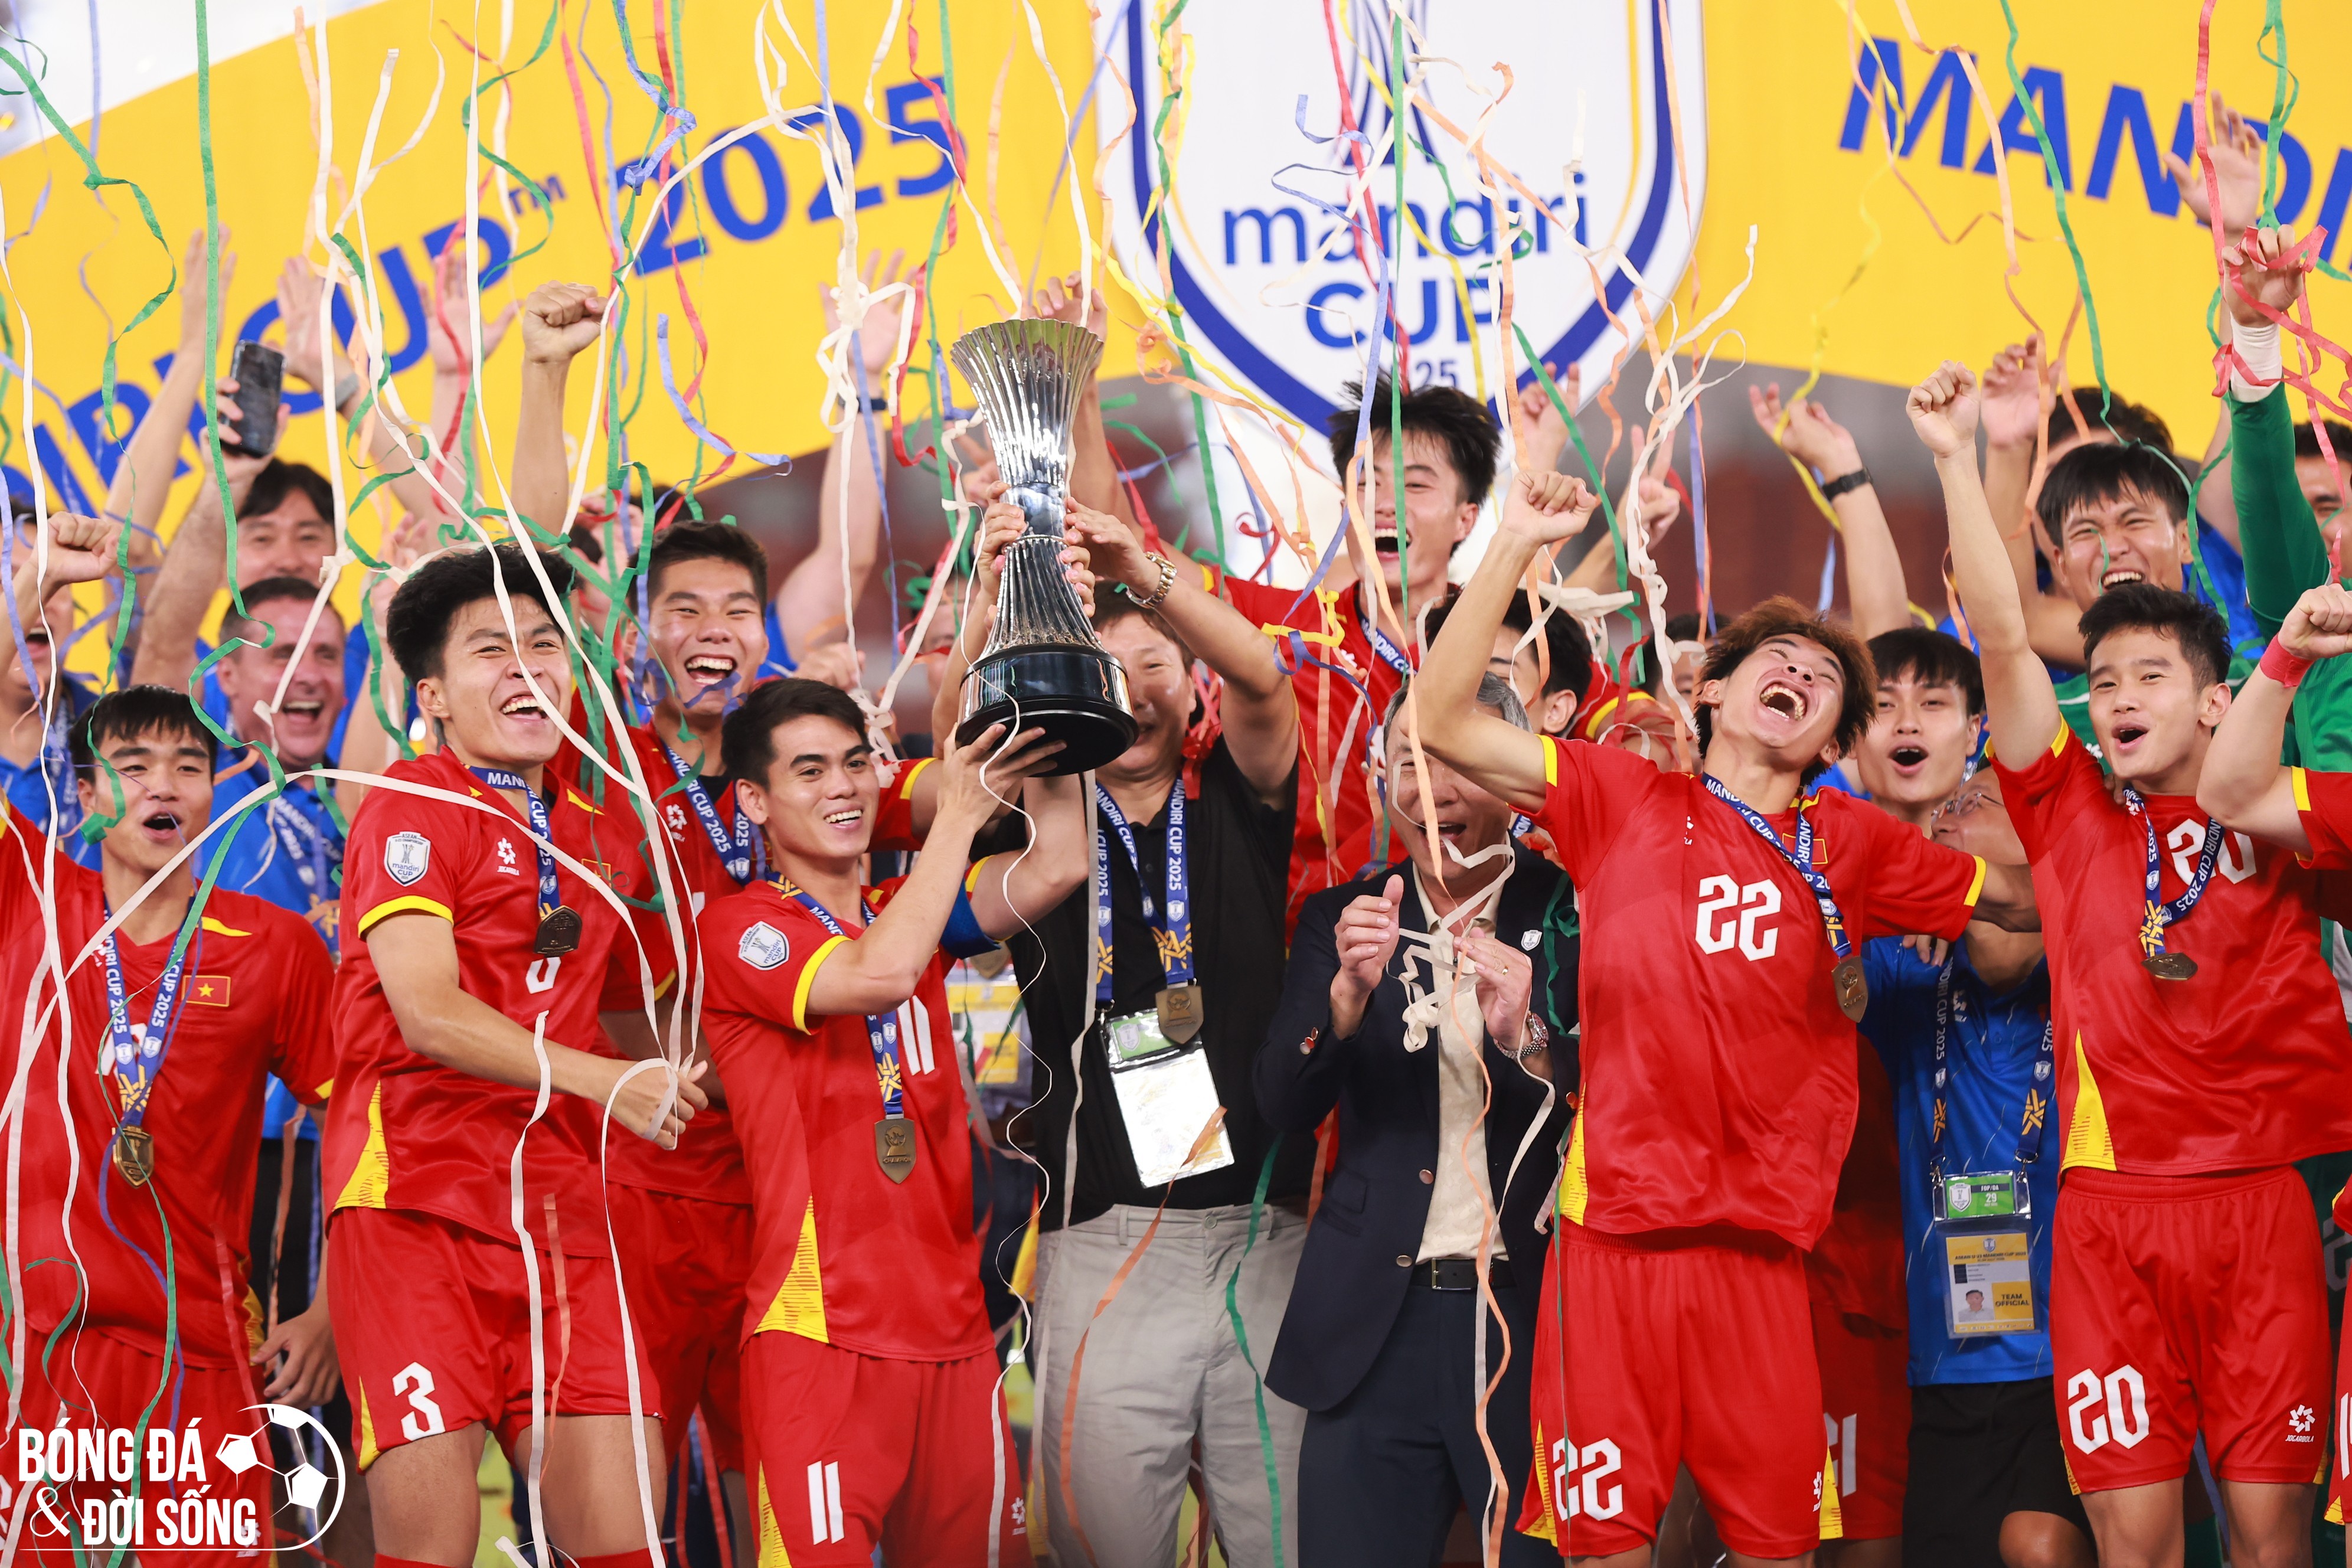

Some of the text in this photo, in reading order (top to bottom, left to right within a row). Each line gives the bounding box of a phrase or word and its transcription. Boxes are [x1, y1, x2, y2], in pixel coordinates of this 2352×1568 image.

[618, 76, 967, 277] 2025
[1223, 170, 1587, 266] mandiri
[1304, 280, 1511, 349] CUP
[531, 800, 548, 829] CUP
[691, 793, 714, 818] CUP
[705, 819, 732, 853] 2025
[735, 812, 749, 847] 2025
[1749, 816, 1775, 840] CUP
[536, 832, 552, 866] 225
[1118, 827, 1135, 854] CUP
[1169, 827, 1182, 855] CUP
[2148, 828, 2157, 863] 2025
[2167, 818, 2256, 884] 20
[392, 863, 420, 873] mandiri
[1168, 857, 1182, 891] 2025
[2198, 855, 2212, 882] CUP
[2176, 881, 2202, 912] 2025
[1695, 874, 1782, 962] 22
[742, 930, 753, 945] ASEAN
[764, 939, 782, 964] mandiri
[771, 947, 782, 961] CUP
[106, 968, 123, 997] CUP
[162, 964, 180, 993] CUP
[109, 998, 128, 1034] 2025
[151, 993, 172, 1028] 2025
[1937, 999, 1947, 1025] CUP
[1936, 1028, 1946, 1060] 2025
[1985, 1193, 1997, 1203] 29
[392, 1361, 446, 1442] 3
[2067, 1364, 2151, 1455] 20
[1552, 1437, 1623, 1521] 22
[806, 1461, 845, 1545] 11
